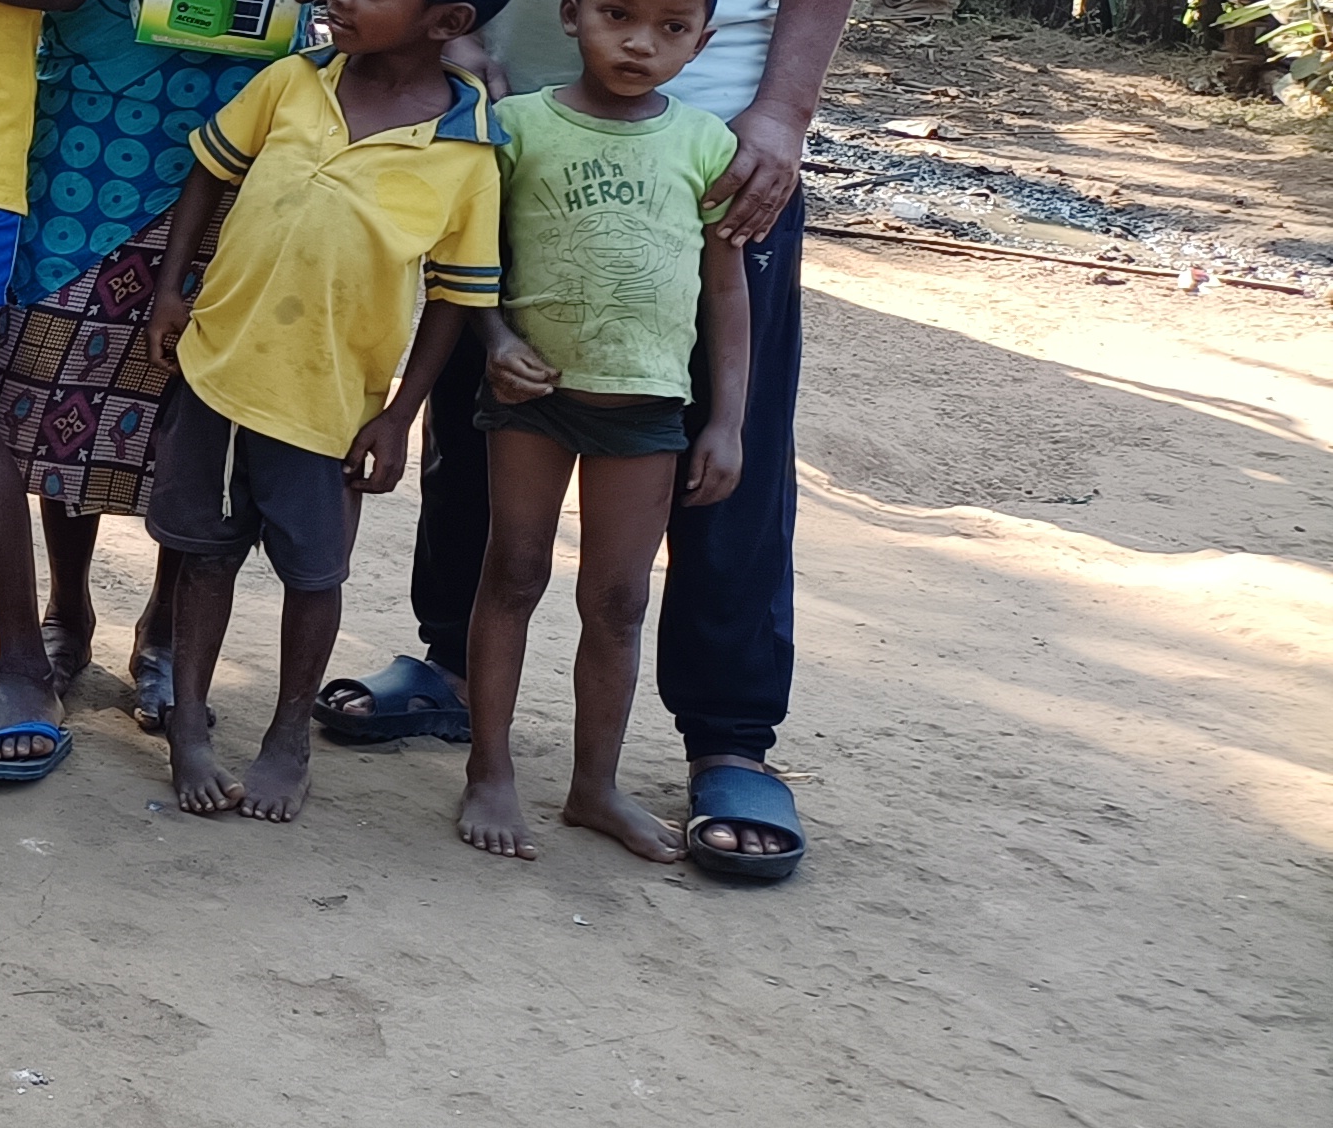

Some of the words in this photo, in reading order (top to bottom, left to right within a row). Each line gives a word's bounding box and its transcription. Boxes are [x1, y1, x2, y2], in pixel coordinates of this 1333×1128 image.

[563, 158, 606, 186] I'M
[612, 163, 624, 178] A
[564, 180, 645, 212] HERO!
